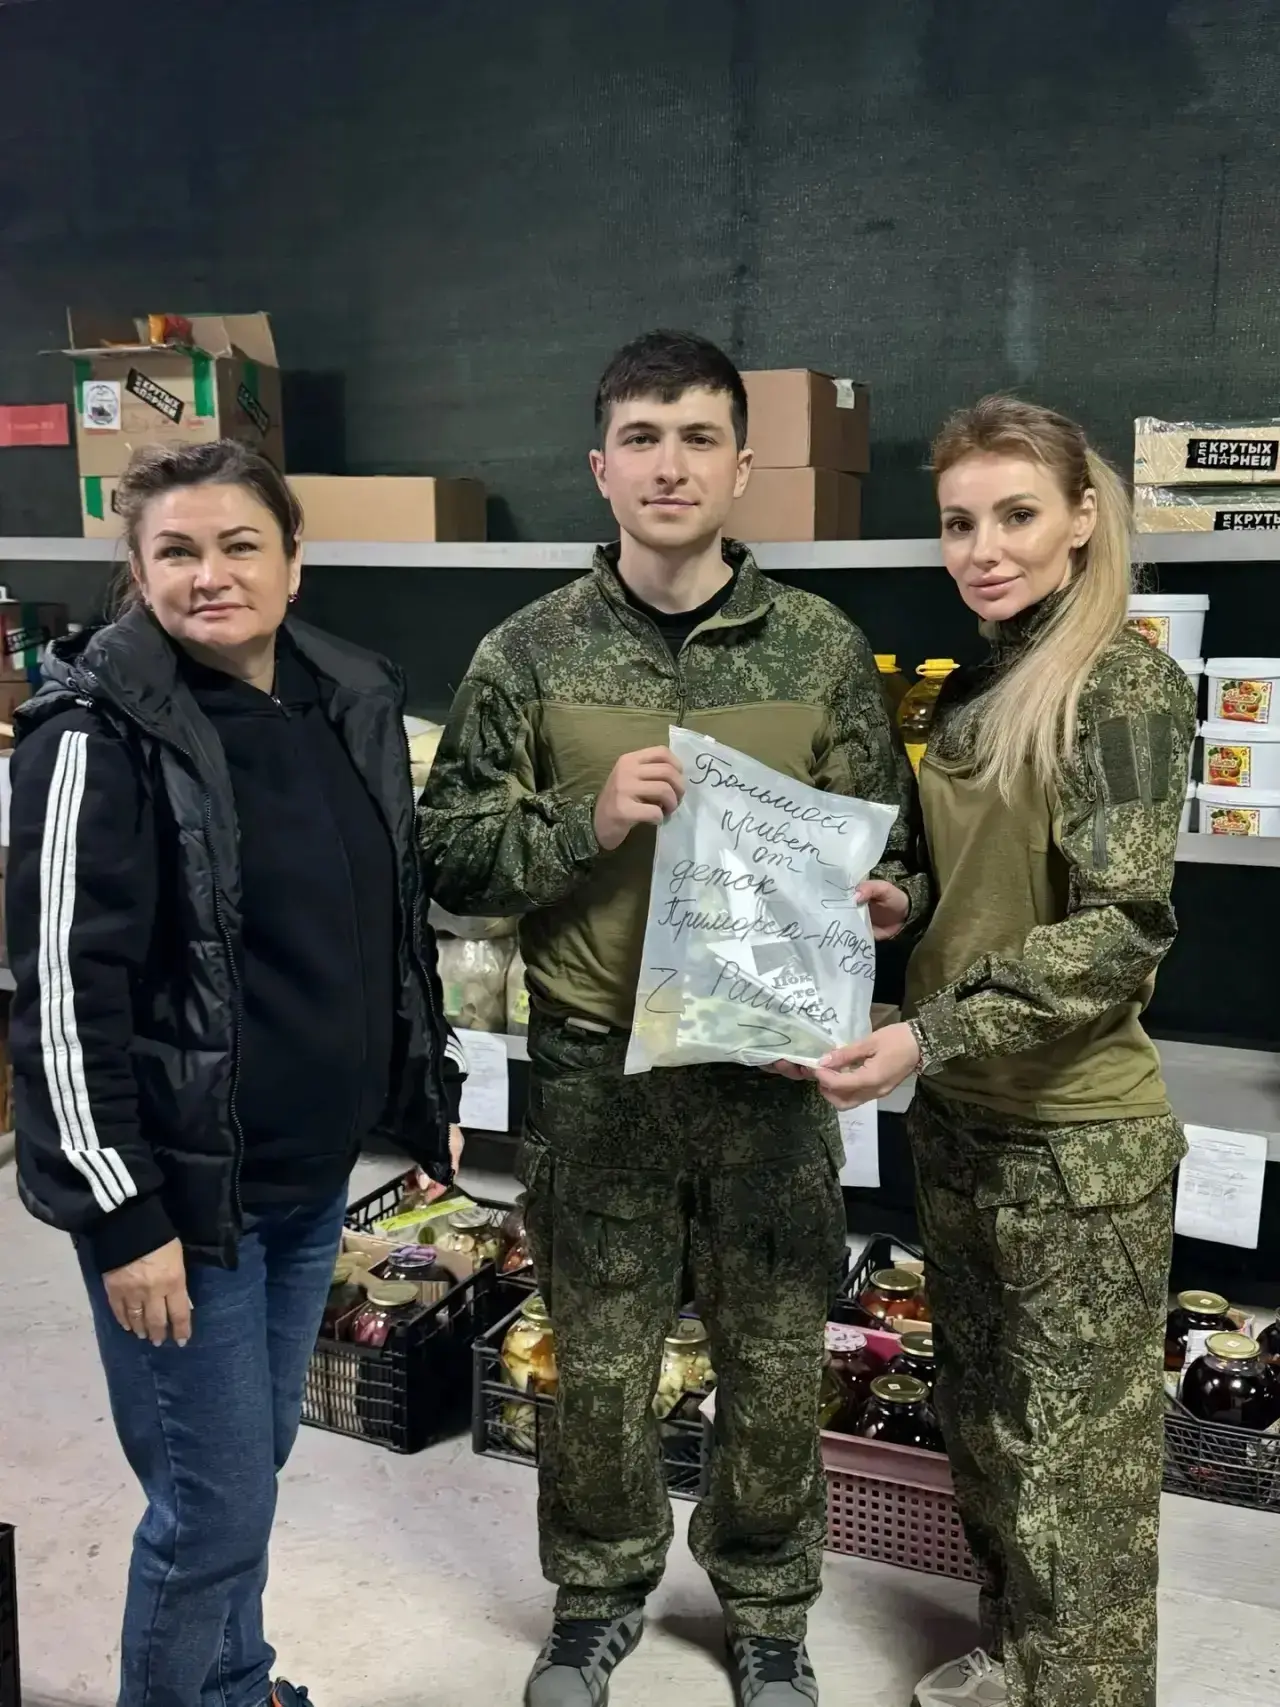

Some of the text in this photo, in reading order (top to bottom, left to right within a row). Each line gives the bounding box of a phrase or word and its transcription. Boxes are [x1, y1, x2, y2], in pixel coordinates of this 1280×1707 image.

[1209, 441, 1272, 454] КРУТЫХ
[1222, 513, 1232, 531] ЛЯ
[689, 752, 852, 835] Большой
[752, 846, 804, 874] от
[669, 858, 778, 897] деток
